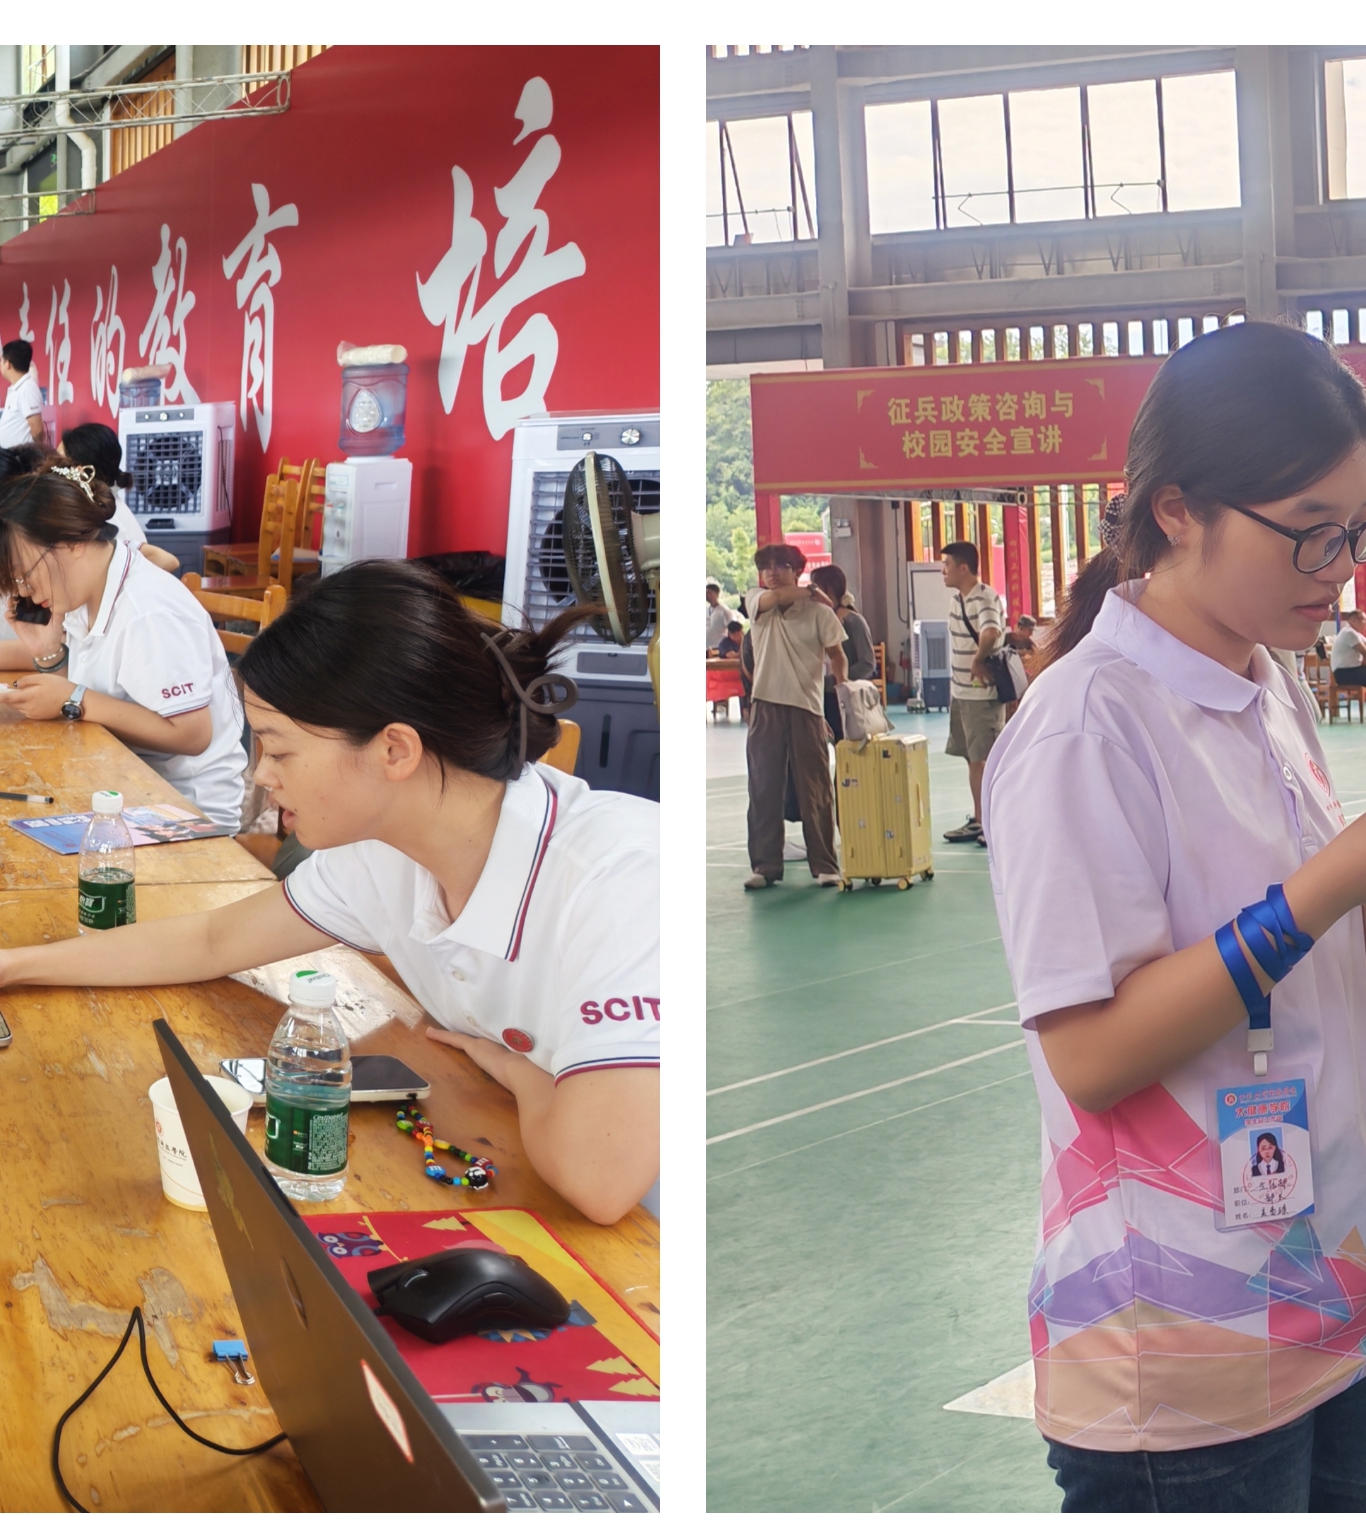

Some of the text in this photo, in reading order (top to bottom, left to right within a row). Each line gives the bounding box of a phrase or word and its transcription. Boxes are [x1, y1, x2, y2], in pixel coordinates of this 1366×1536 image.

[416, 76, 585, 440] 培
[887, 389, 1075, 426] 征兵政策咨询与
[901, 424, 1064, 460] 校园安全宣讲
[161, 682, 195, 699] SCIT
